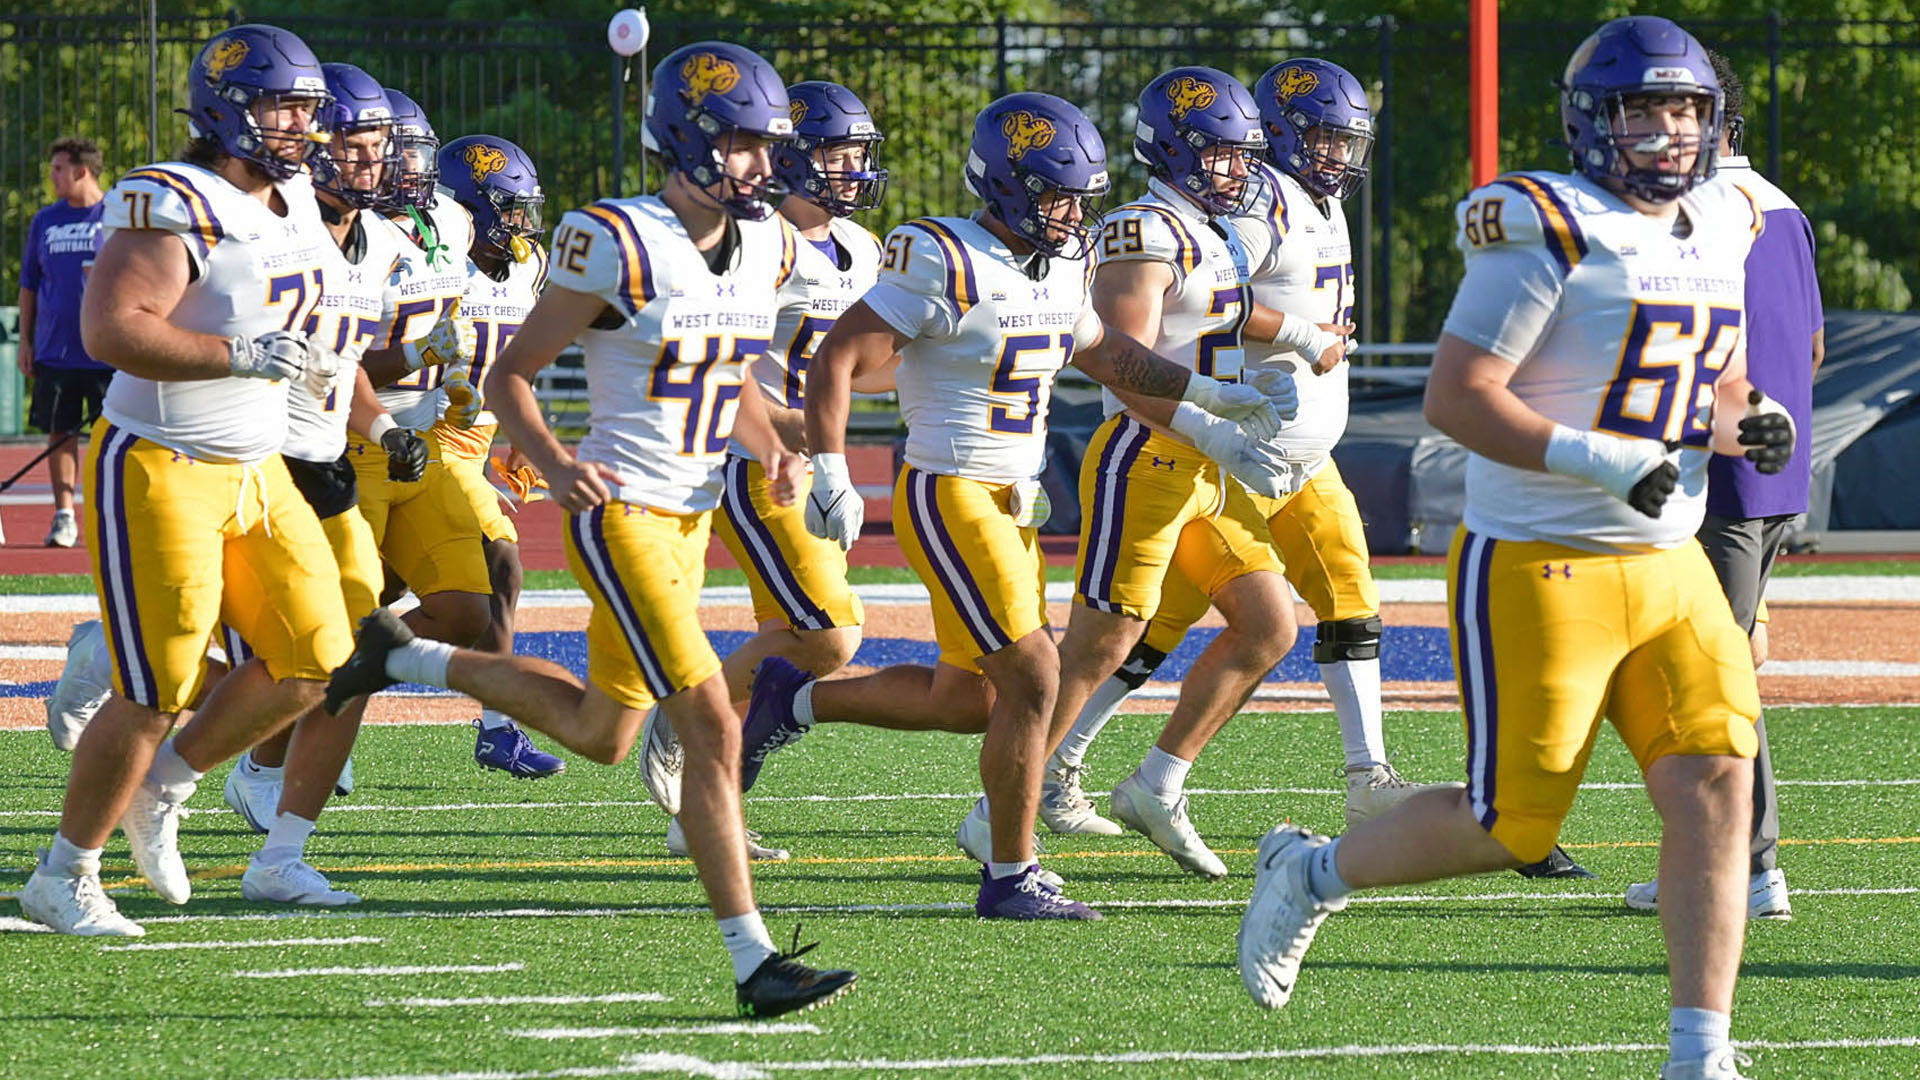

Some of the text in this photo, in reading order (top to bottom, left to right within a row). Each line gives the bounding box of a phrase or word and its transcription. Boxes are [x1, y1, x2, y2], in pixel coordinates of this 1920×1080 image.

[123, 190, 153, 229] 71
[1465, 198, 1506, 248] 68
[555, 224, 596, 277] 42
[884, 233, 915, 275] 51
[1104, 218, 1145, 257] 29
[400, 281, 428, 297] WEST
[1638, 276, 1680, 293] WEST
[460, 305, 492, 317] WEST
[672, 313, 713, 329] WEST
[812, 298, 840, 311] WEST
[998, 314, 1034, 328] WEST
[1591, 299, 1742, 451] 68
[646, 334, 773, 458] 42
